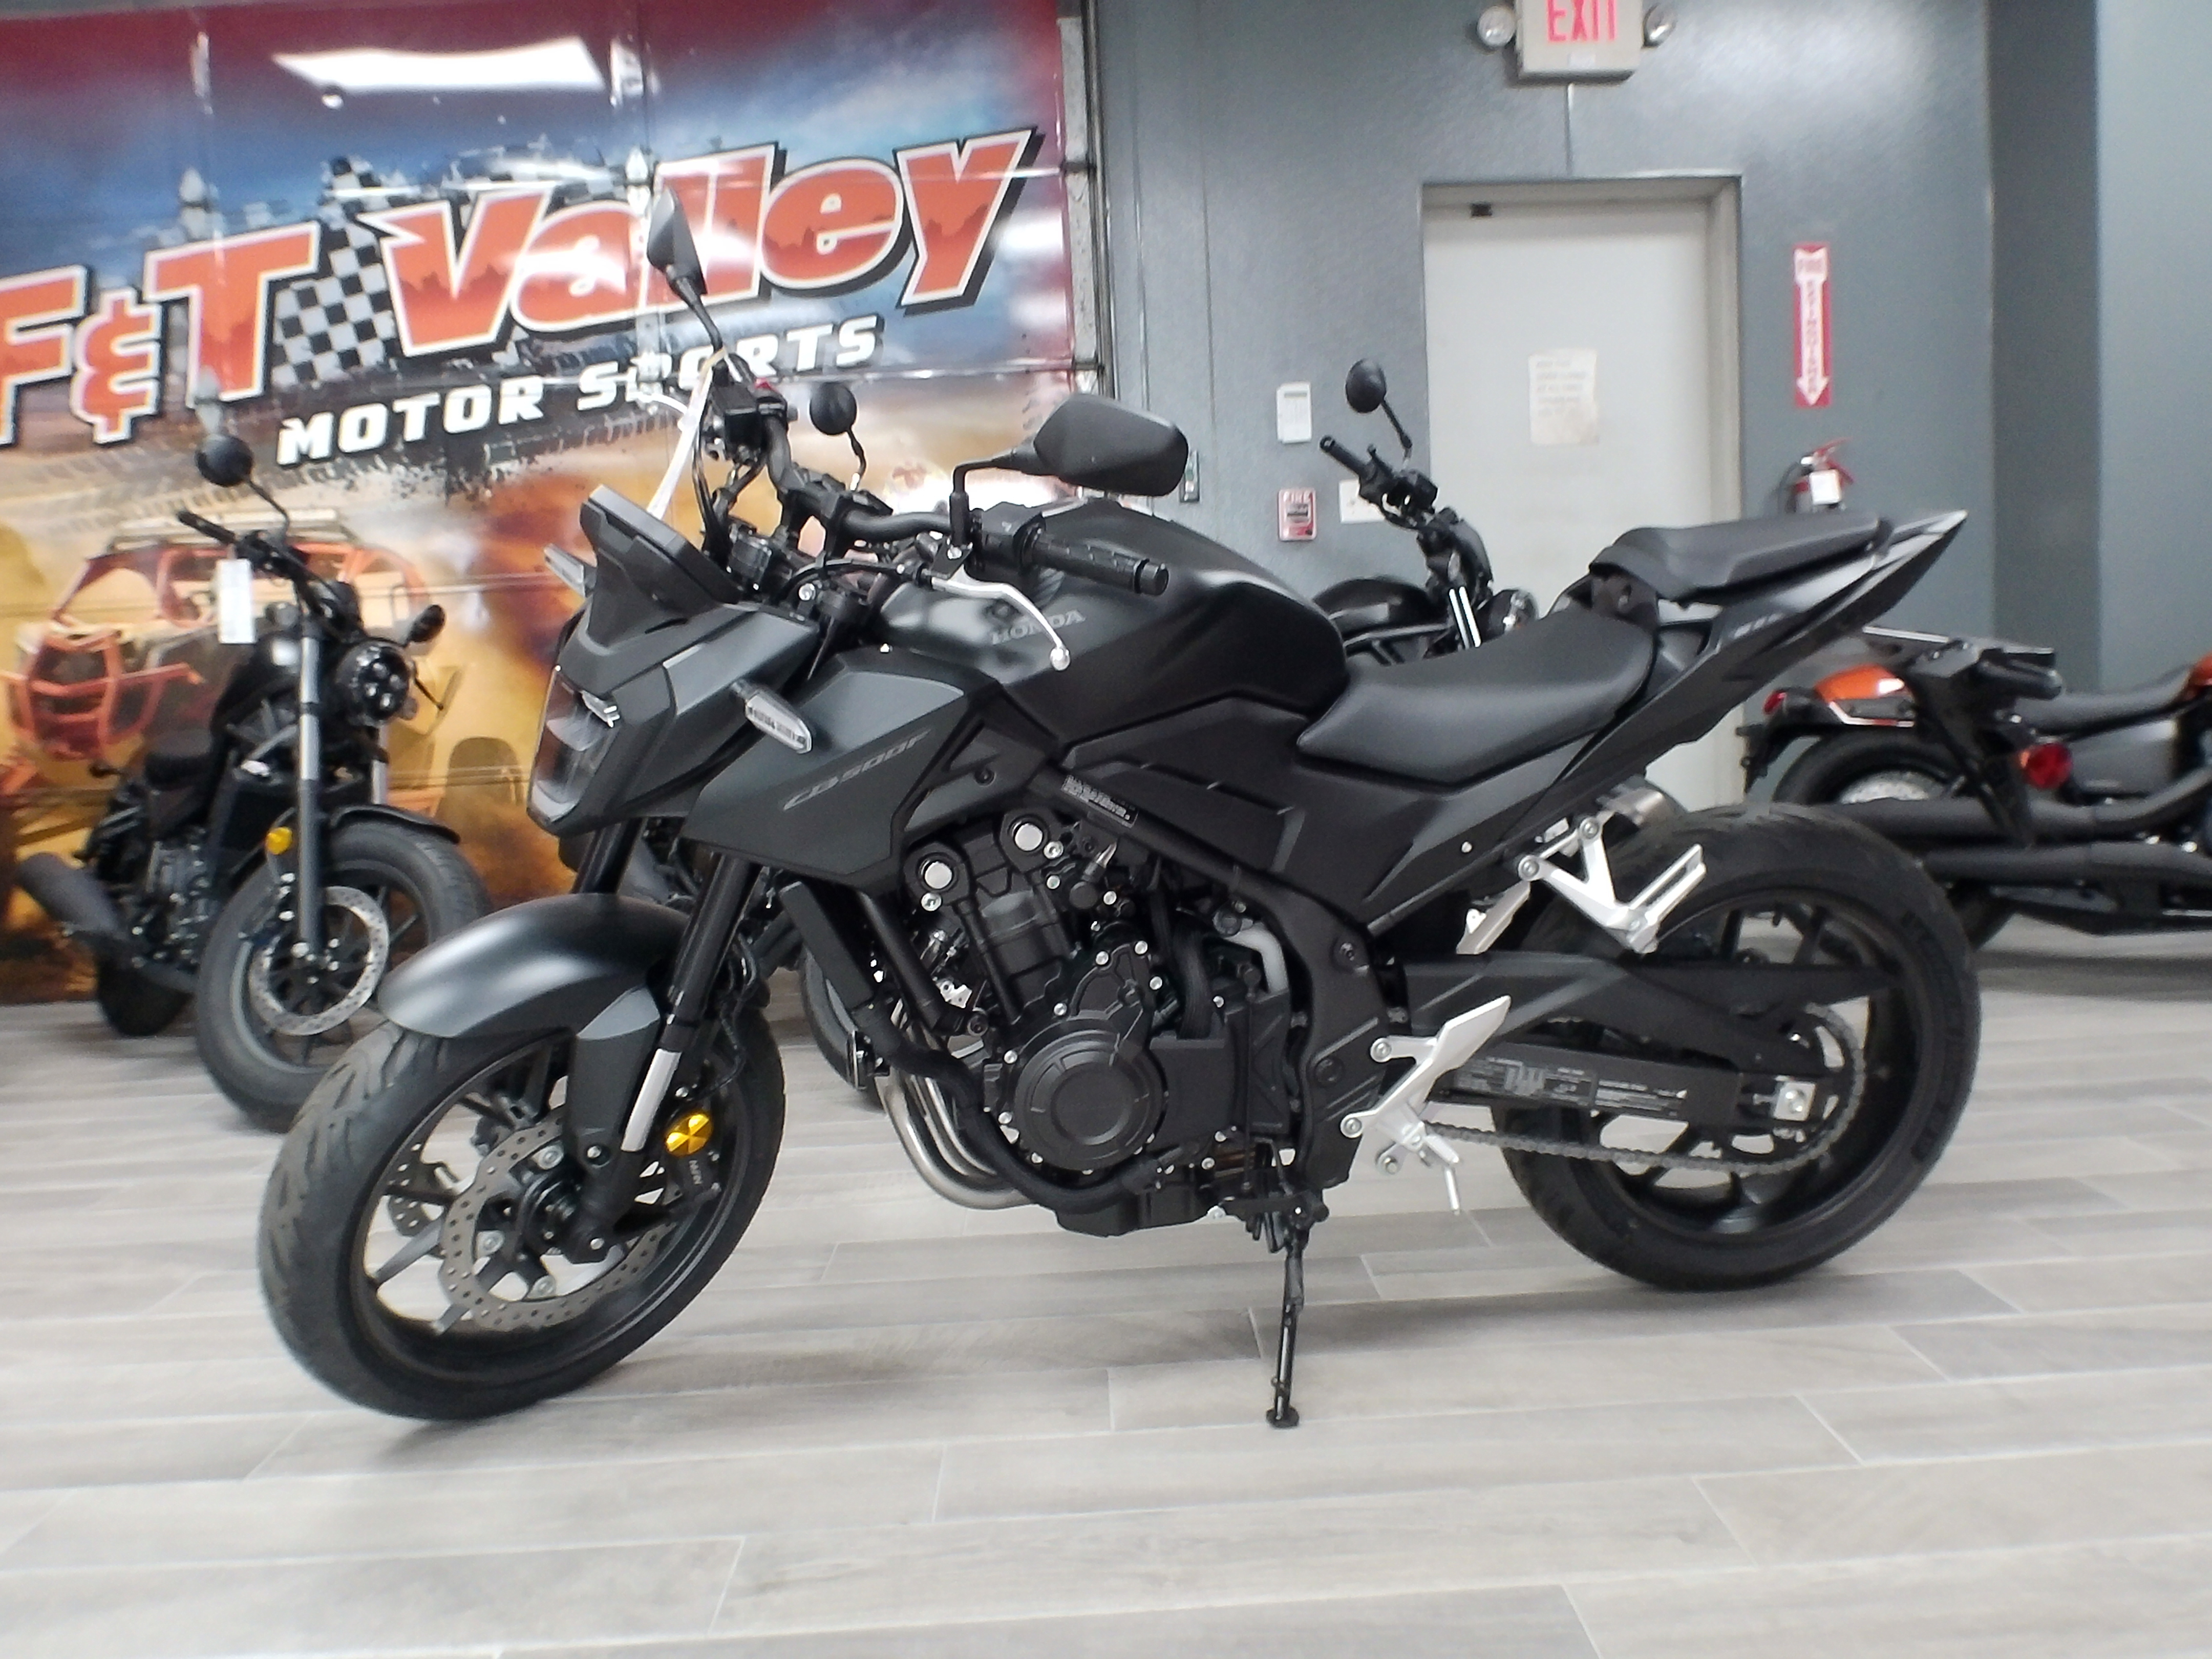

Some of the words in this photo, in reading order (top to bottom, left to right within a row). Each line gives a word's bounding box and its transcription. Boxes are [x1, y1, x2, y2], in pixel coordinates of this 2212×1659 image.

[1547, 0, 1617, 42] EXIT
[355, 128, 1036, 358] Valley
[275, 374, 546, 466] MOTOR
[991, 609, 1087, 645] HONDA
